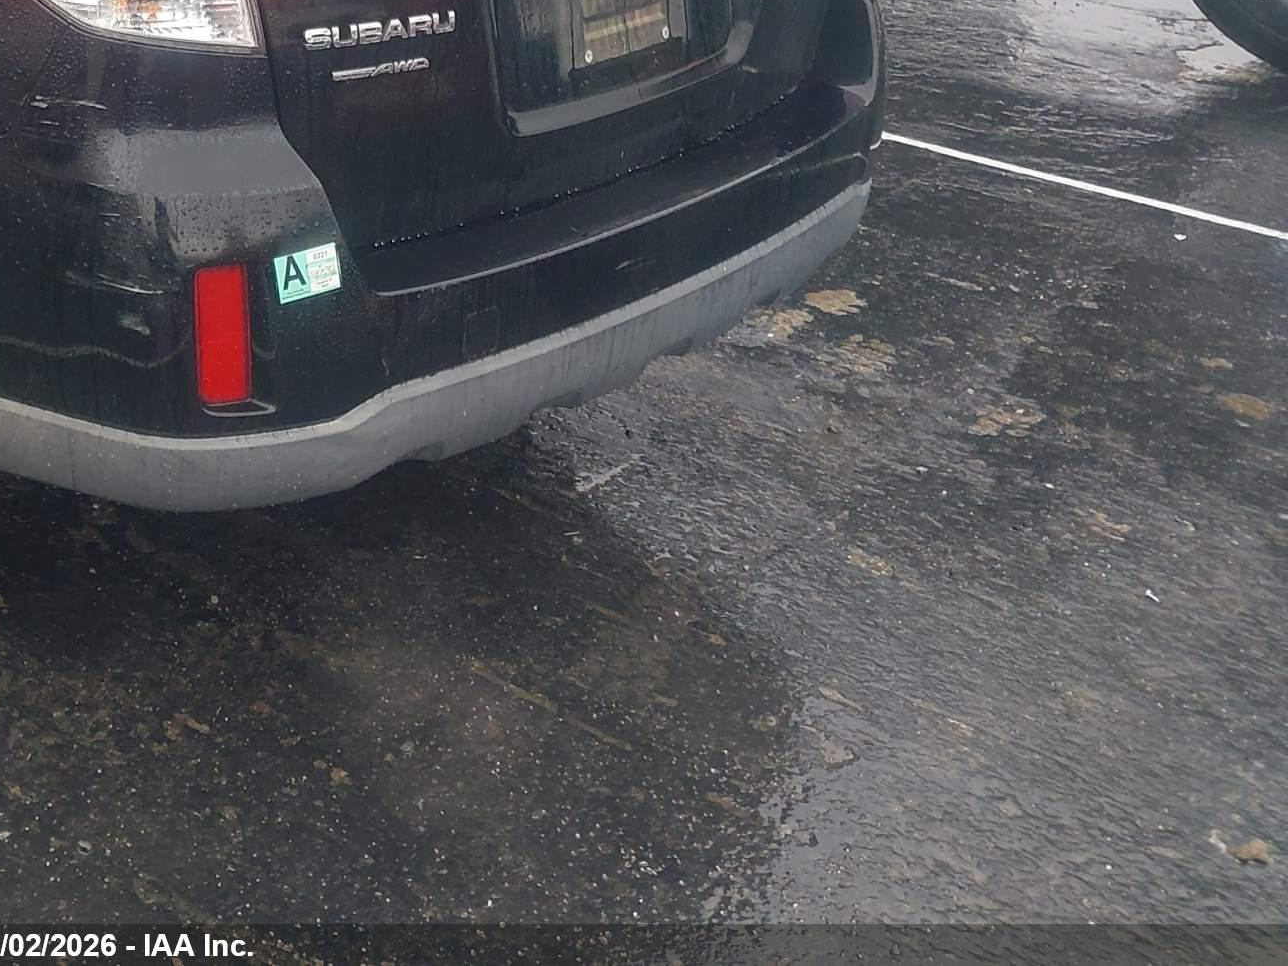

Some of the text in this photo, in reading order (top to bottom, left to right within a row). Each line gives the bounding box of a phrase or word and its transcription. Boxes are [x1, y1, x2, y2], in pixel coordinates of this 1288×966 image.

[304, 10, 456, 51] SUBARU
[371, 57, 430, 77] AWD
[283, 256, 307, 290] A
